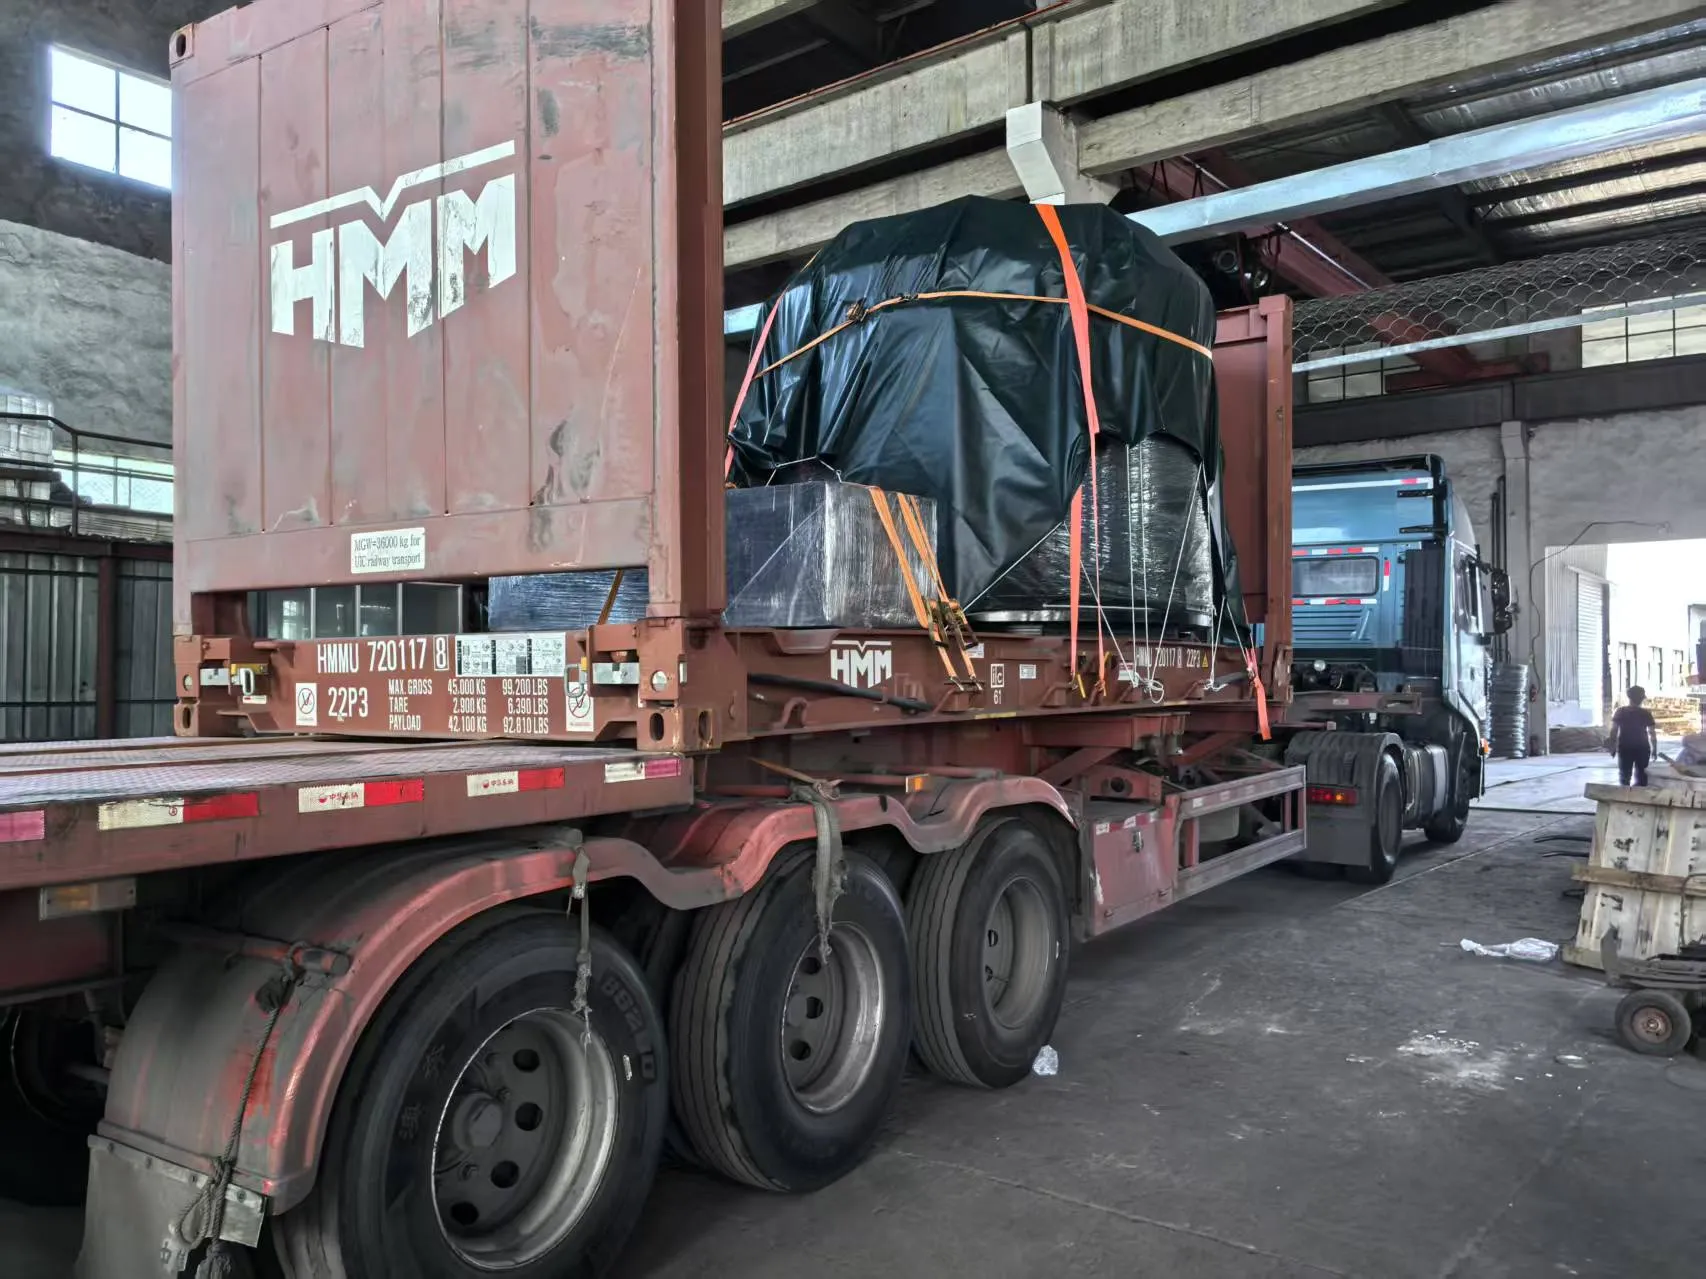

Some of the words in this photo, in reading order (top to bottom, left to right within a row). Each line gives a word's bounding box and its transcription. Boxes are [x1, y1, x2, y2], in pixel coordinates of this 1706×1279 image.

[271, 174, 516, 349] HMM
[399, 536, 409, 549] kg
[410, 534, 421, 546] for
[367, 554, 390, 568] railway
[391, 552, 421, 567] transport
[317, 642, 359, 674] HMMU
[367, 638, 427, 672] 720117
[435, 637, 447, 670] 8
[830, 649, 893, 689] HMM
[388, 679, 406, 695] MAX.
[407, 678, 432, 695] GROSS
[475, 679, 486, 695] KG
[532, 679, 548, 695] LBS
[327, 687, 369, 718] 22P3
[389, 697, 408, 713] TARE
[475, 698, 487, 713] KG
[993, 690, 1002, 705] 61
[532, 698, 549, 714] LBS
[389, 715, 421, 731] PAYLOAD
[476, 716, 487, 732] KG
[533, 717, 549, 733] LBS
